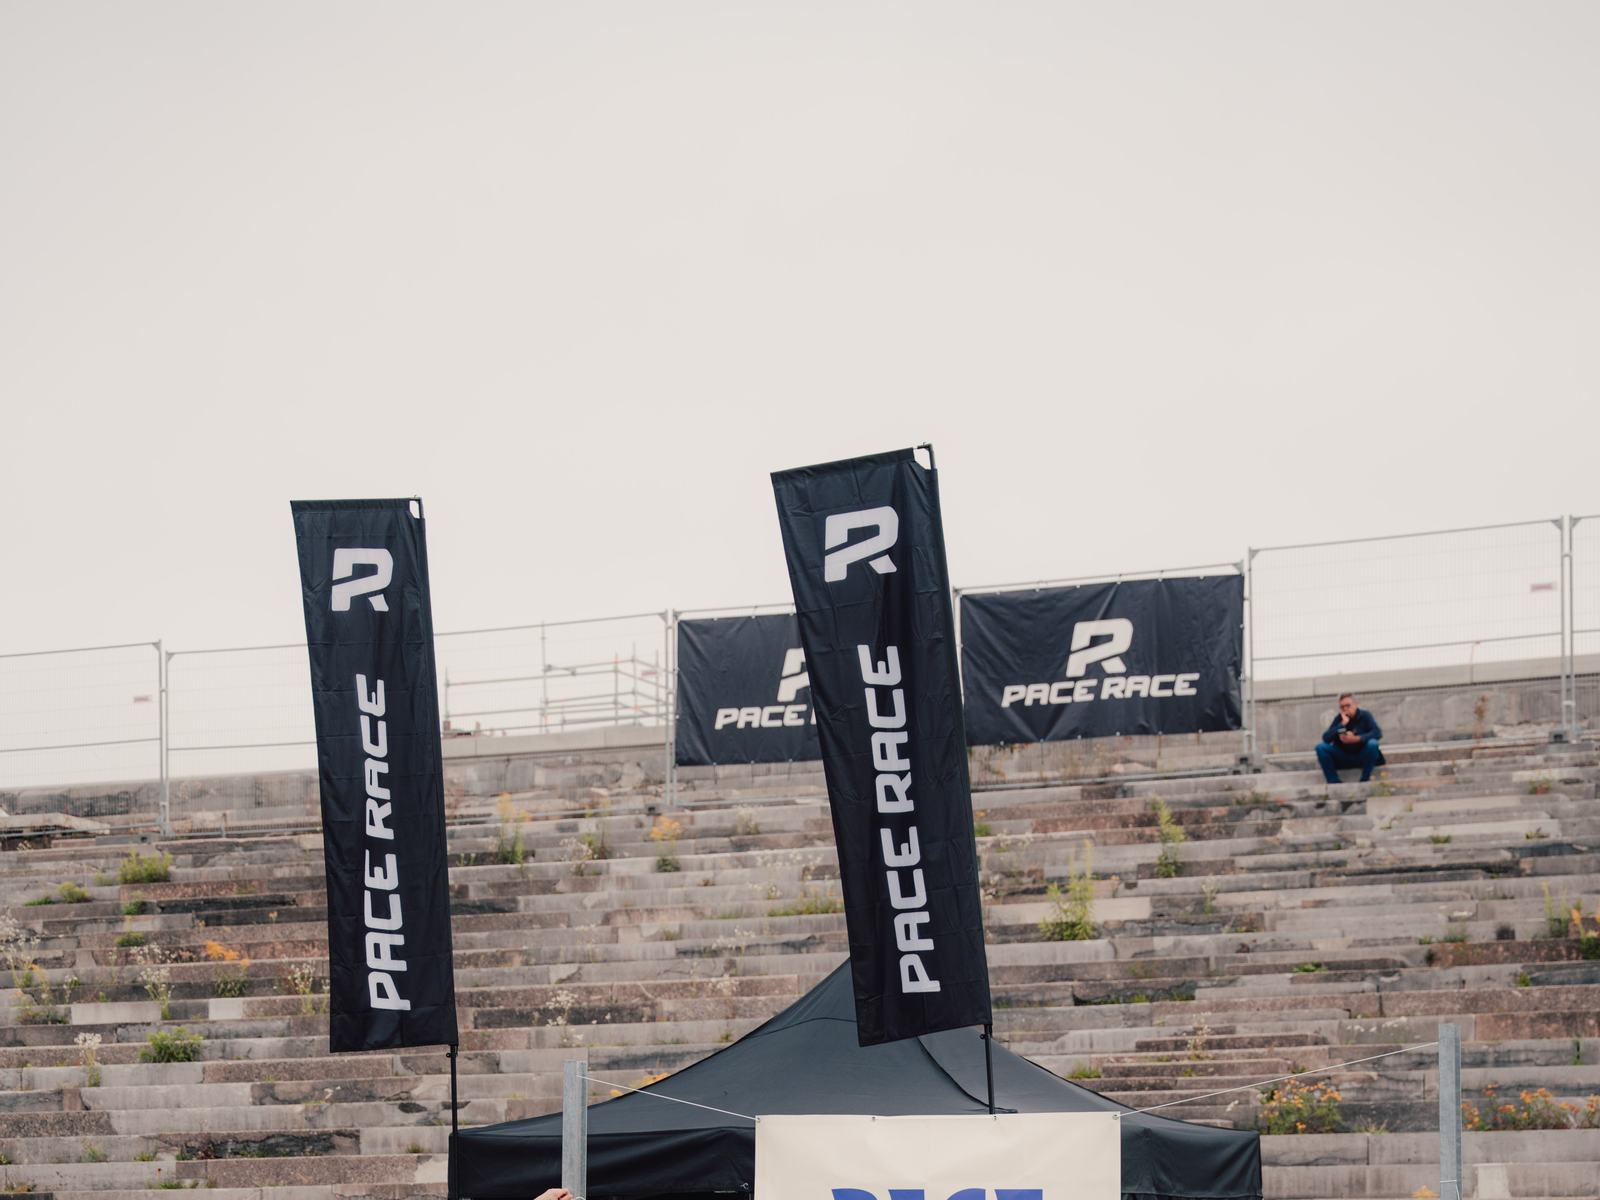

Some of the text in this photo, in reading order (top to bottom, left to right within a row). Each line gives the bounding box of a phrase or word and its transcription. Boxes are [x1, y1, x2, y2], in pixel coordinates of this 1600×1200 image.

[825, 506, 898, 583] R
[331, 547, 394, 612] R
[1066, 617, 1134, 678] R
[714, 704, 807, 730] PACE
[1001, 672, 1200, 708] PACE RACE
[356, 674, 410, 1010] PACE RACE
[858, 645, 940, 993] PACE RACE
